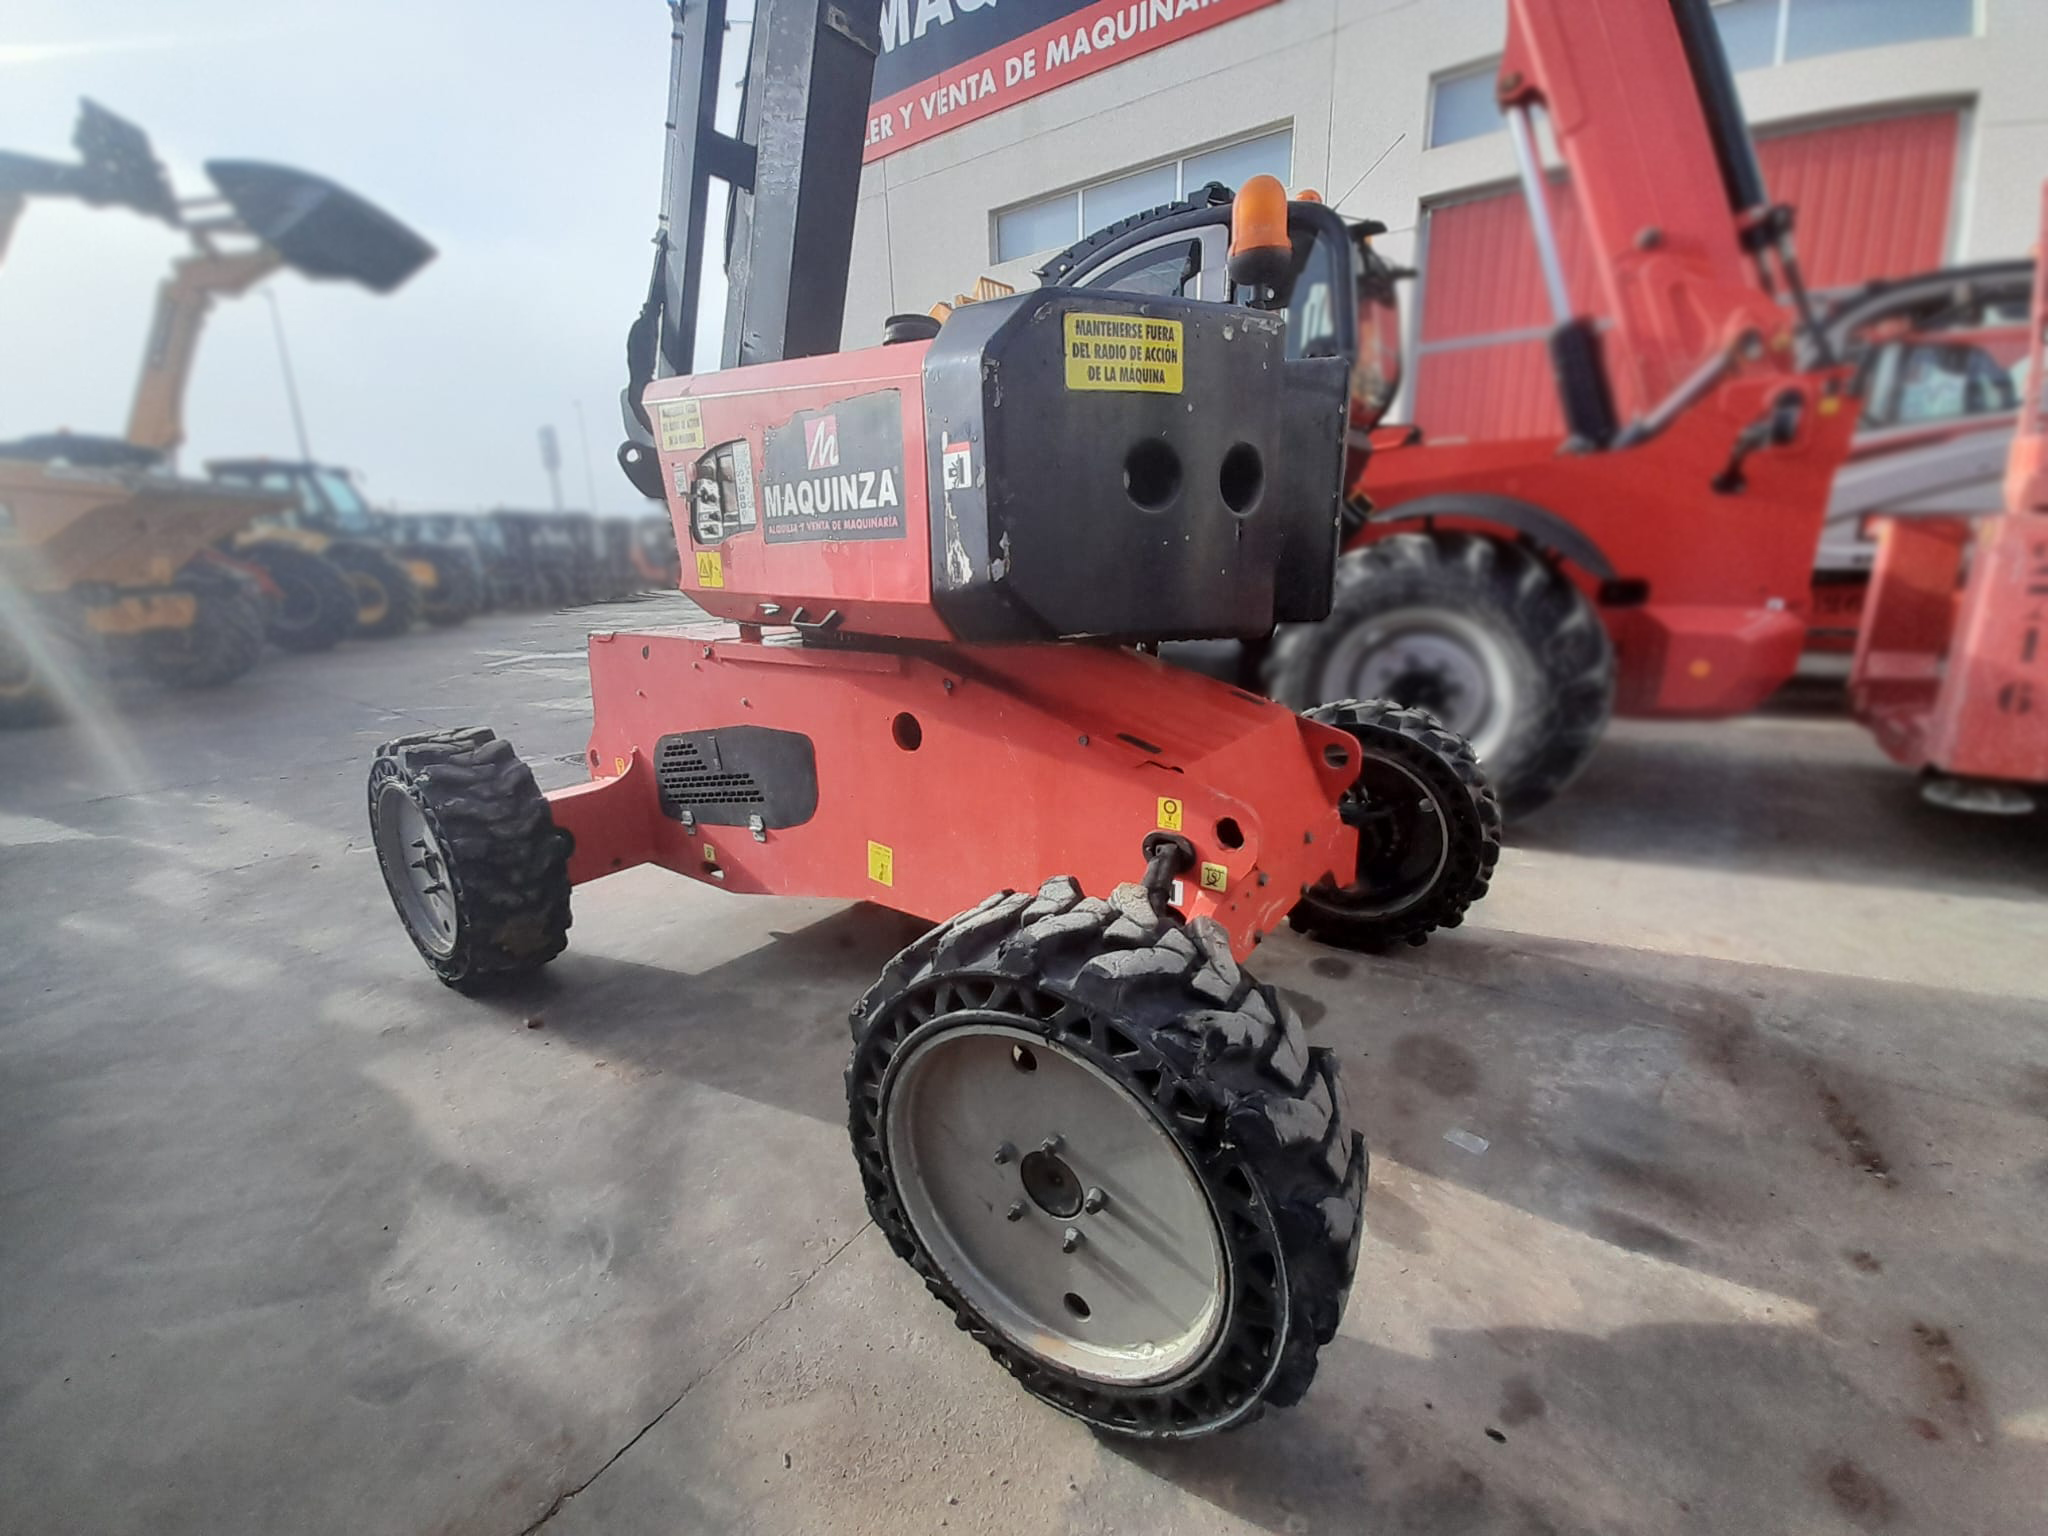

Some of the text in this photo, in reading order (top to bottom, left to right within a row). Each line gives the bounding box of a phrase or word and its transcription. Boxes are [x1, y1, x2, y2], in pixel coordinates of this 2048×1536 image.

[880, 0, 998, 53] MA
[899, 101, 914, 130] Y
[920, 68, 997, 120] VENTA
[1004, 48, 1037, 88] DE
[1045, 0, 1222, 71] MAQUINA
[1075, 319, 1175, 342] MANTENERSE FUERA
[1072, 342, 1178, 363] DEL RADIO DE ACCIÓN
[1087, 363, 1166, 384] DE LA MÁQUINA
[764, 469, 898, 517] MAQUINZA
[831, 519, 843, 531] DE
